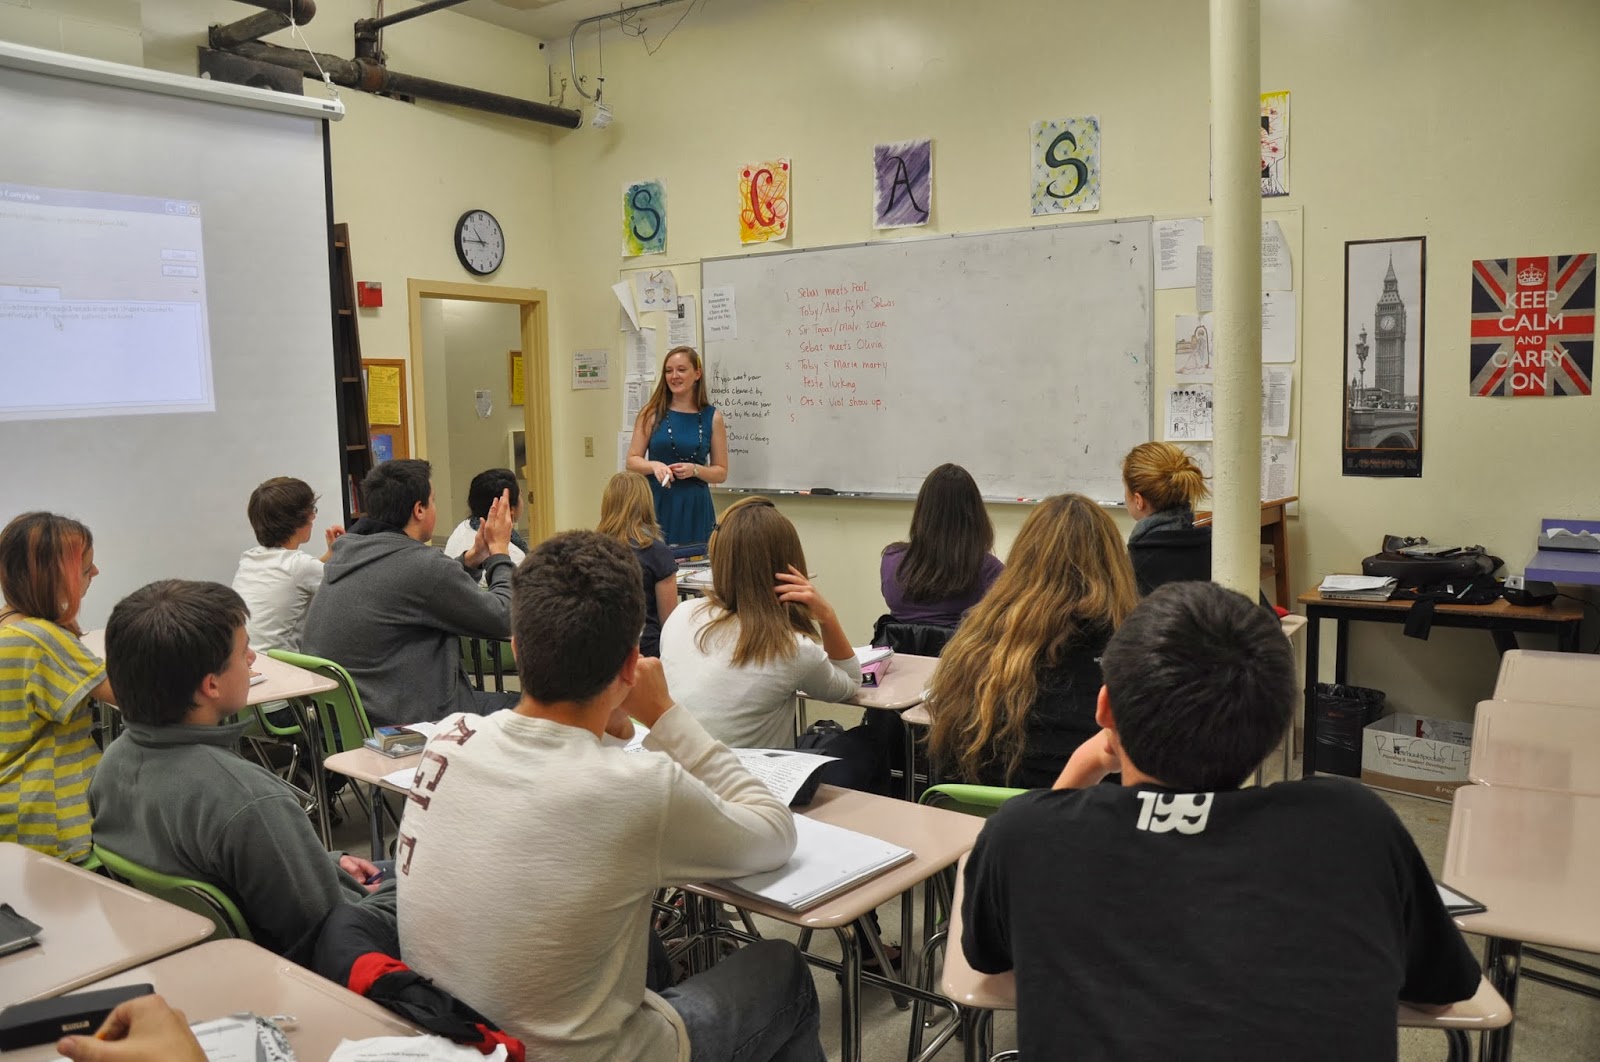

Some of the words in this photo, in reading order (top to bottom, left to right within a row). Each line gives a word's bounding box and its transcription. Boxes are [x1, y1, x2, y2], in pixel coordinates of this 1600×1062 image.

[1045, 130, 1088, 199] S
[882, 156, 928, 218] A
[750, 168, 775, 227] C
[632, 189, 661, 242] S
[824, 284, 848, 296] meets
[844, 299, 863, 317] fight
[1505, 290, 1559, 309] KEEP
[1498, 312, 1564, 332] CALM
[829, 340, 851, 351] meets
[857, 338, 883, 349] Olivia
[1516, 336, 1544, 345] AND
[1491, 349, 1570, 368] CARRY
[798, 359, 818, 375] Toby
[833, 360, 858, 369] Maria
[862, 361, 887, 377] marry
[720, 377, 731, 385] you
[828, 375, 856, 393] lurking
[1509, 372, 1548, 390] ON
[755, 386, 762, 396] by
[849, 397, 868, 407] show
[735, 409, 742, 419] by
[1425, 761, 1456, 771] Development
